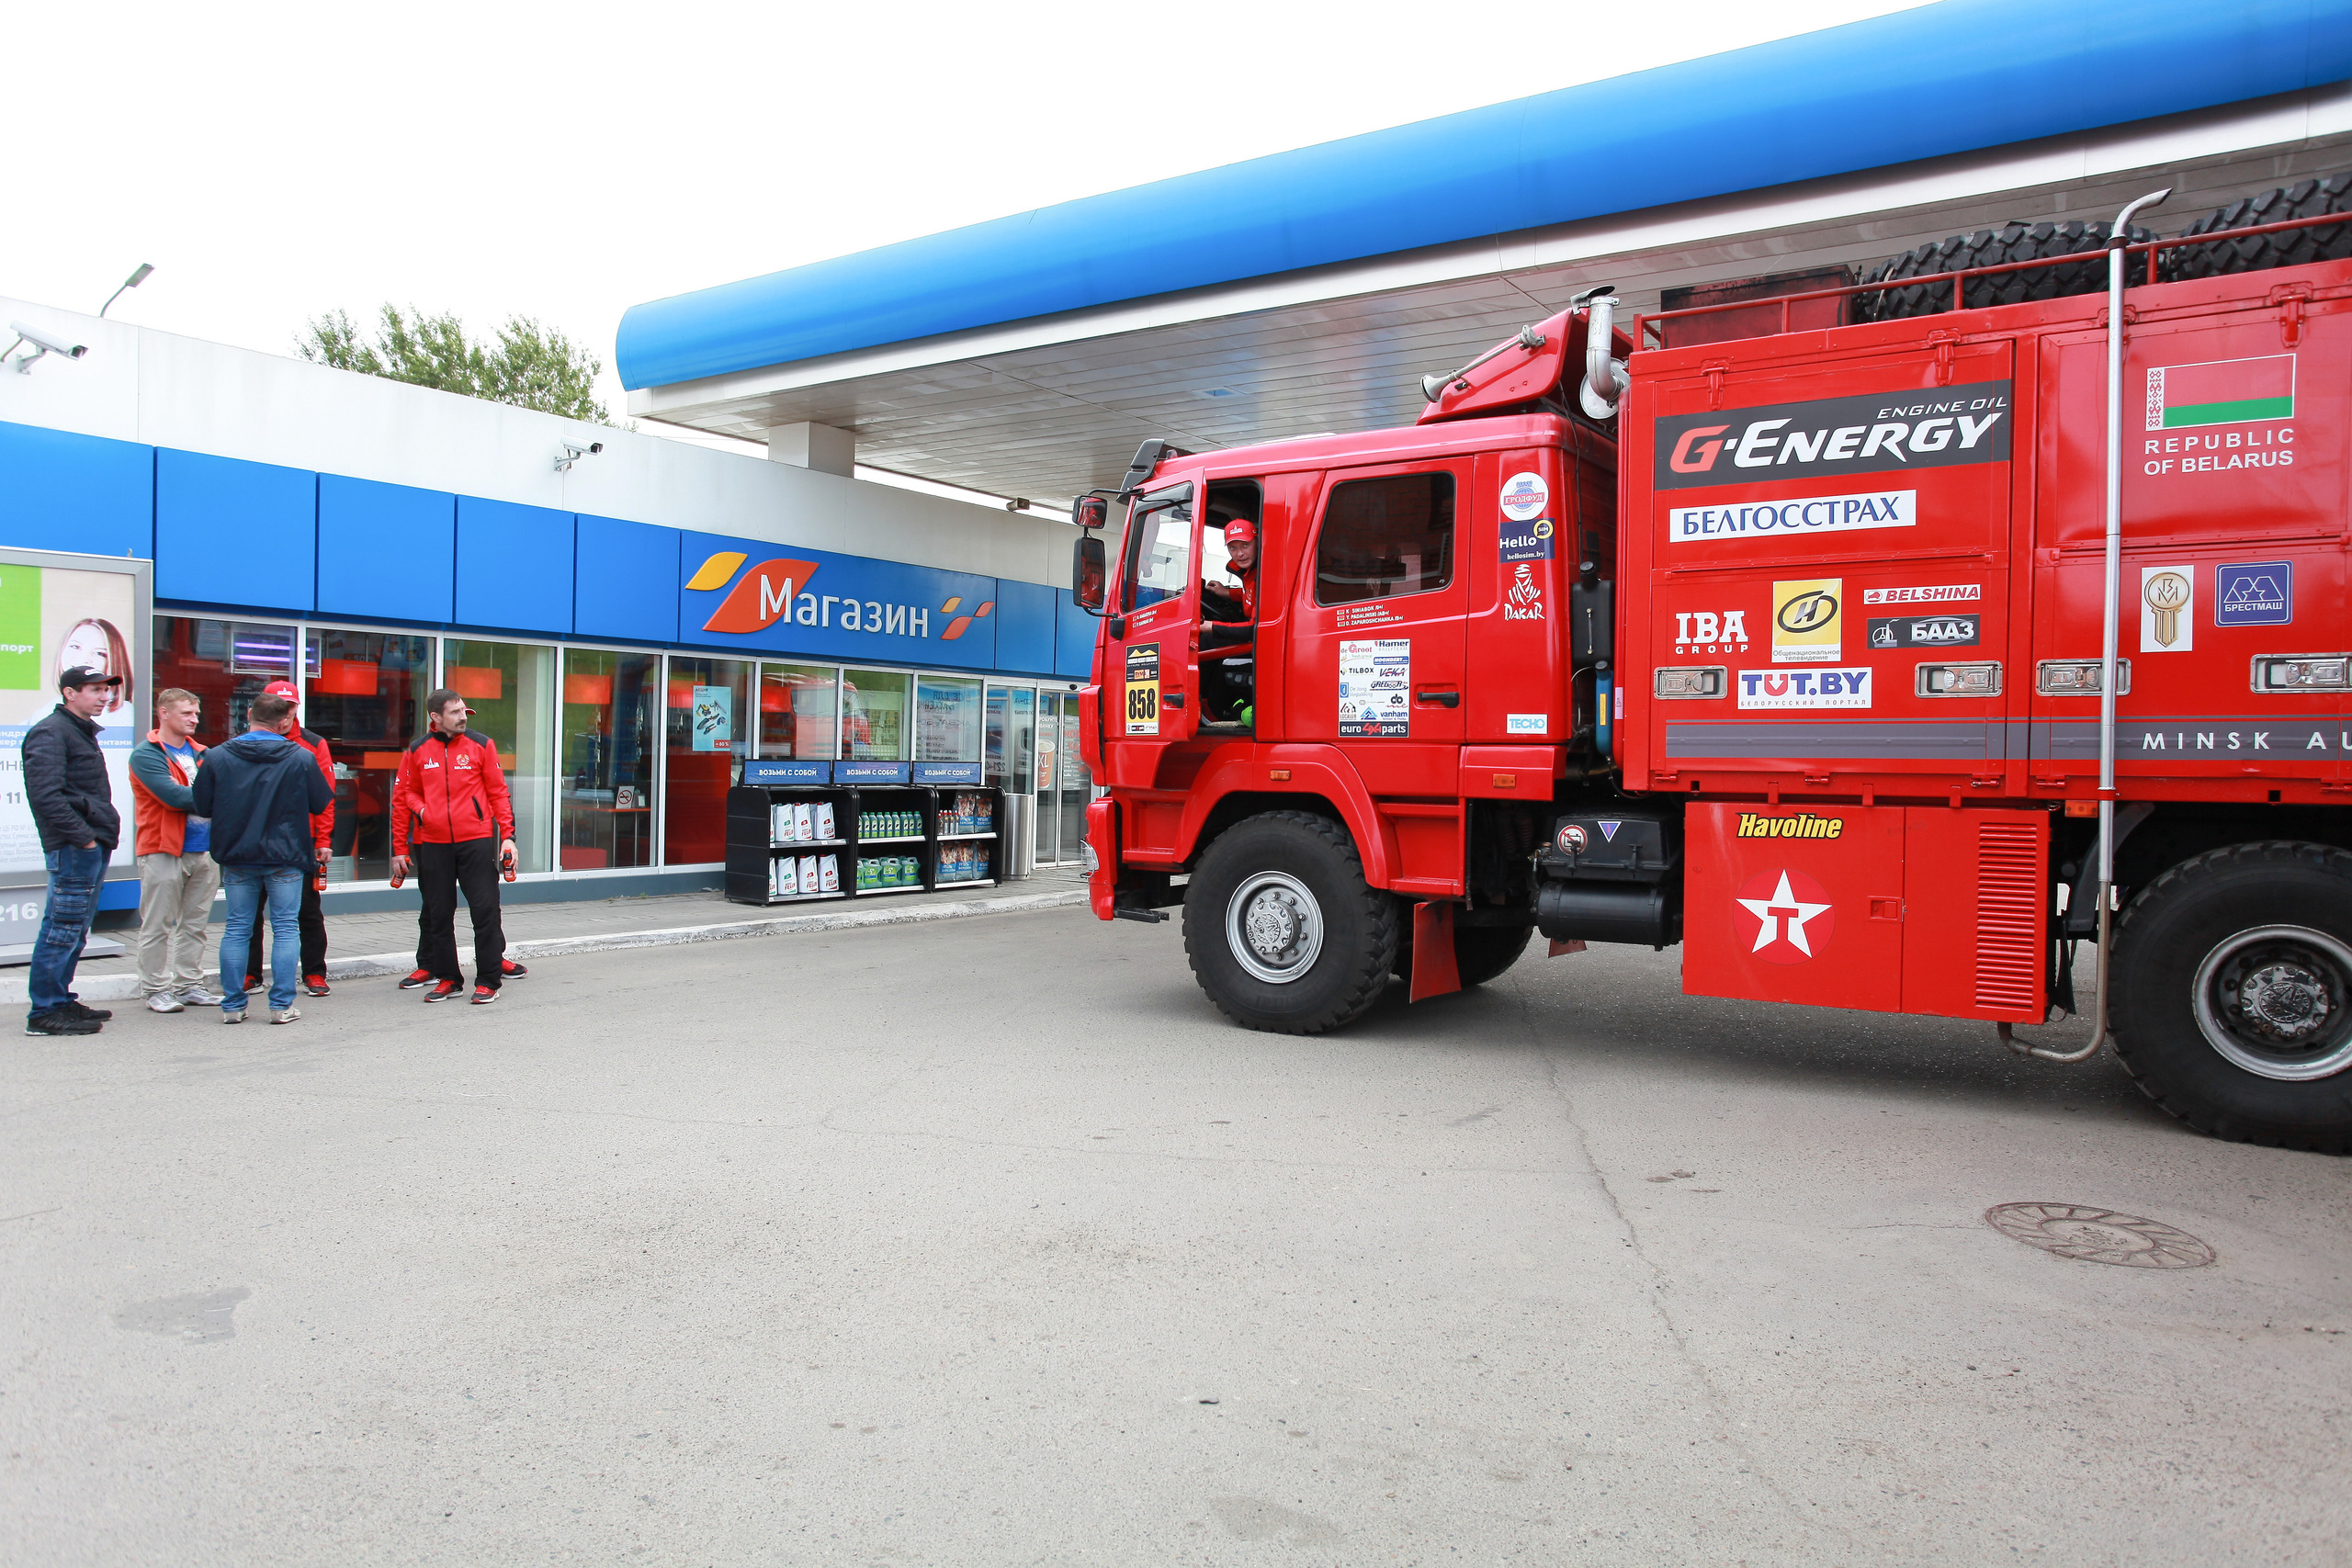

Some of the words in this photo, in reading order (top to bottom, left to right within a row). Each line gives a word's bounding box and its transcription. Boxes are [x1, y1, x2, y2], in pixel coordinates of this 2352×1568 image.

[1876, 400, 1965, 419] ENGINE
[1969, 396, 2007, 411] OIL
[2144, 428, 2294, 455] REPUBLIC
[2143, 459, 2175, 476] OF
[2181, 450, 2293, 473] BELARUS
[1504, 494, 1544, 503] ГРОДФУД
[1683, 496, 1900, 536] БЕЛГОССТРАХ
[1498, 535, 1537, 549] Hello
[1507, 551, 1545, 560] hellosim.by
[1885, 586, 1979, 602] BELSHINA
[759, 574, 929, 637] Магазин
[1503, 602, 1546, 622] DAKAR
[2224, 603, 2283, 612] БРЕСТМАШ
[1675, 611, 1749, 644] IBA
[1911, 622, 1974, 640] БААЗ
[1349, 644, 1373, 653] Groot
[1675, 644, 1749, 655] GROUP
[1742, 671, 1868, 696] TUT.BY
[1128, 688, 1156, 720] 858
[2142, 732, 2270, 750] MINSK
[794, 768, 817, 776] СОБОЙ
[877, 768, 899, 776] СОБОЙ
[952, 768, 971, 776] СОБОЙ
[6, 791, 21, 804] 11
[1736, 813, 1844, 839] Havoline
